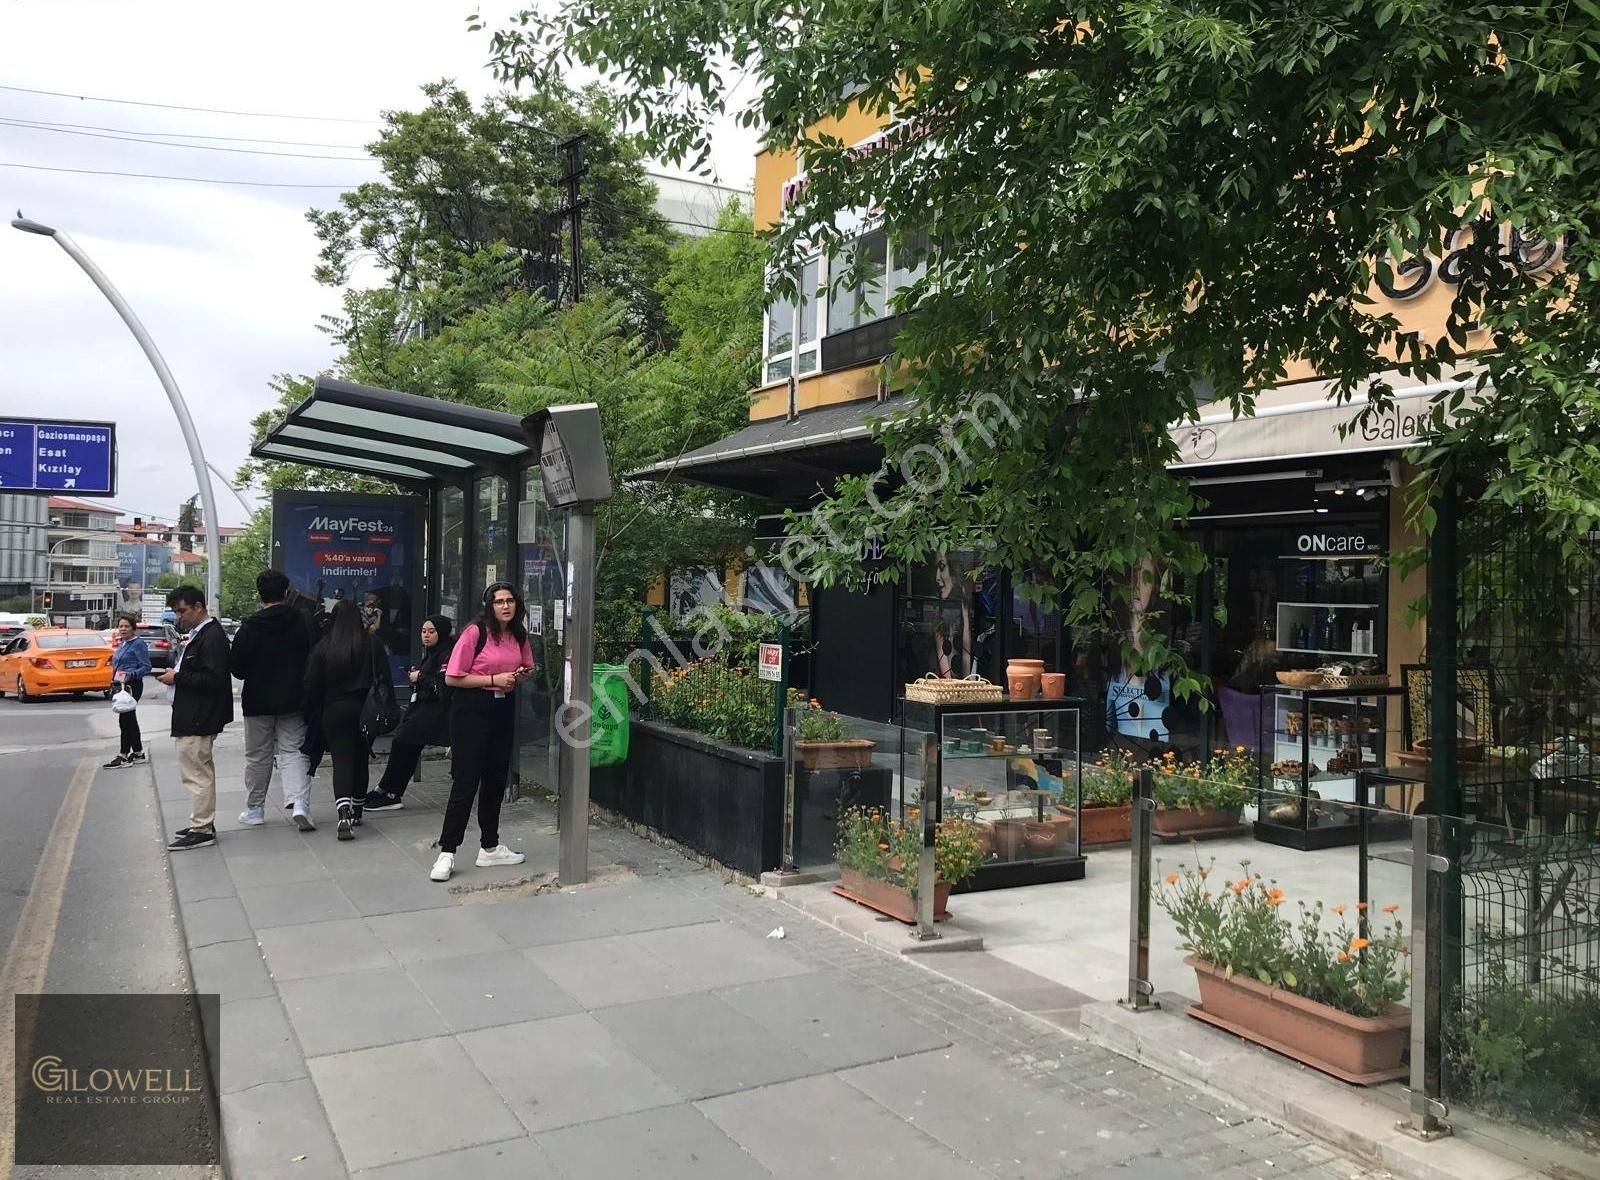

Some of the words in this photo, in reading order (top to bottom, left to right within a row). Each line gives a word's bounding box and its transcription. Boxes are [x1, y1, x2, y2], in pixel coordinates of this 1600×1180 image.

[38, 430, 107, 444] Gaziosmanpaşa
[39, 447, 67, 457] Esat
[38, 463, 82, 476] Kızılay
[1297, 534, 1366, 552] ONcare
[352, 555, 376, 563] varan
[322, 566, 377, 577] indirimler!
